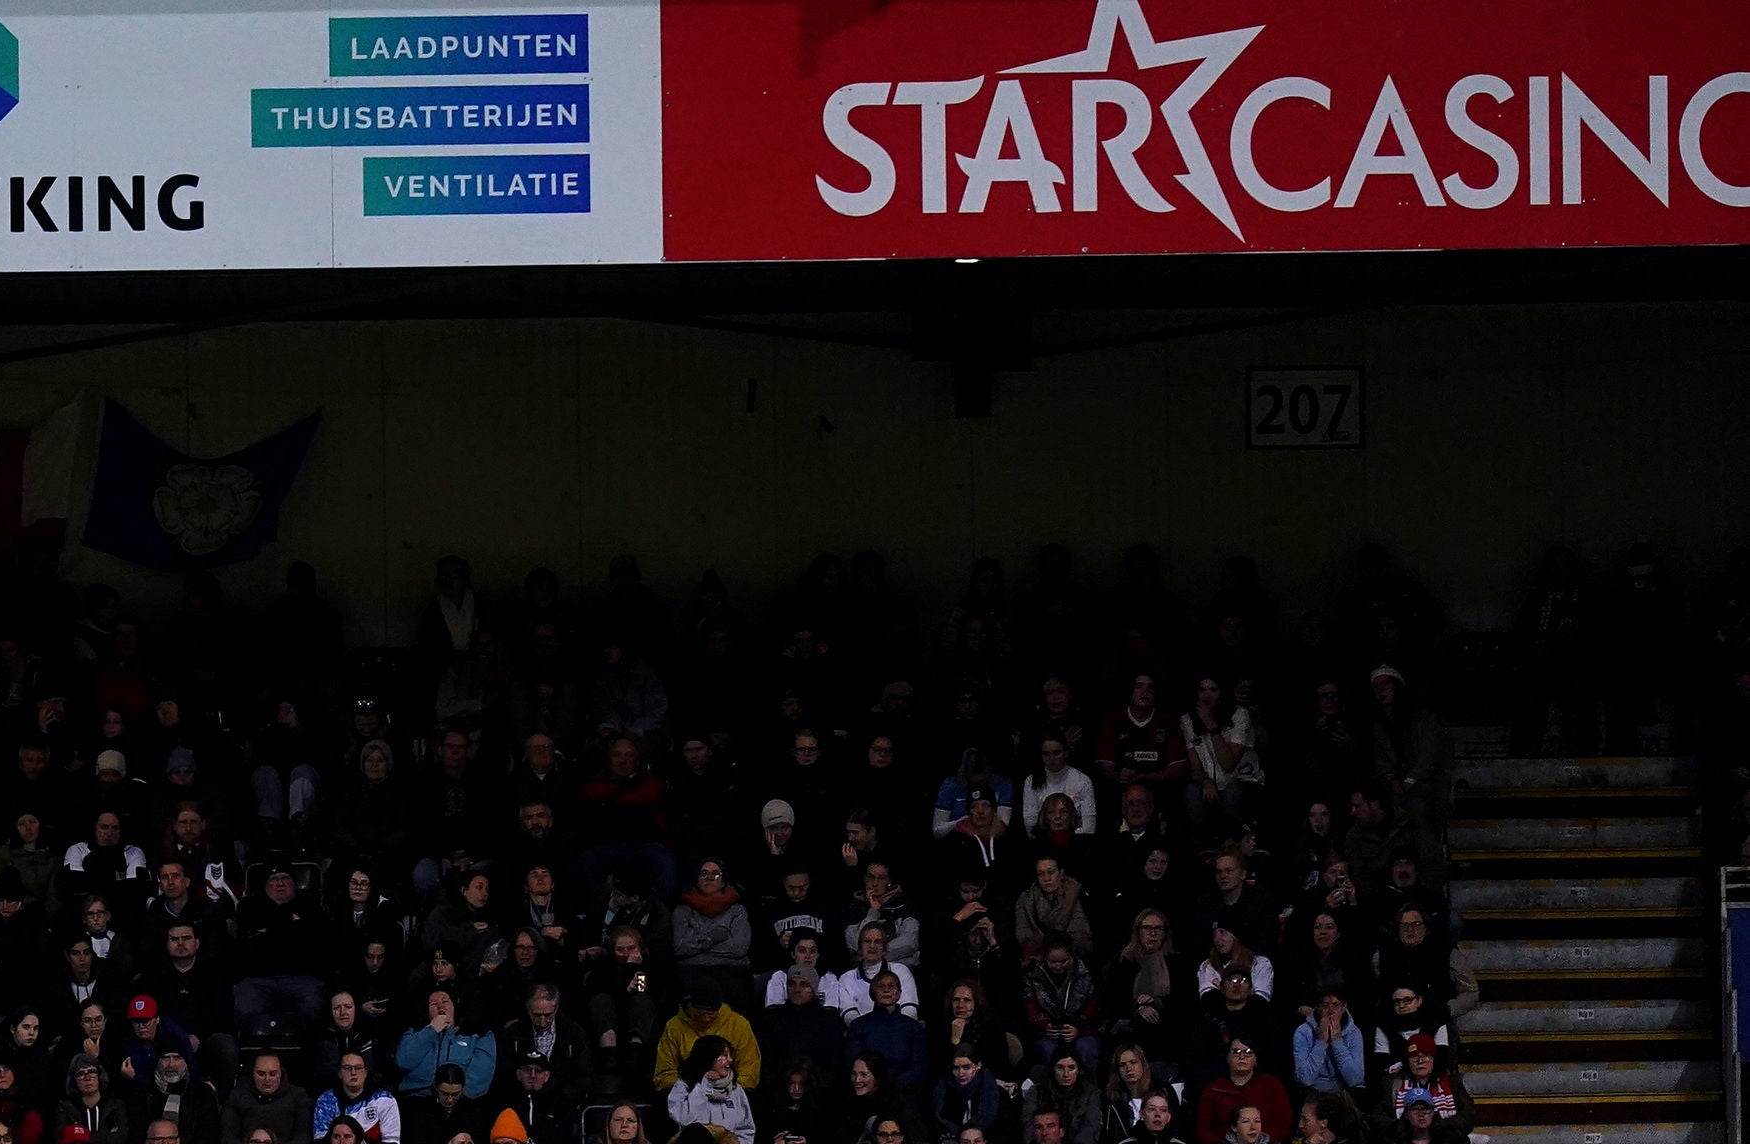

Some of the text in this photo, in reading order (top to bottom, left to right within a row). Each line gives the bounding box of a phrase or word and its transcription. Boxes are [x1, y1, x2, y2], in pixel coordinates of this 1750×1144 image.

[351, 34, 576, 60] LAADPUNTEN
[271, 103, 578, 130] THUISBATTERIJEN
[384, 173, 579, 198] VENTILATIE
[1256, 384, 1351, 442] 207
